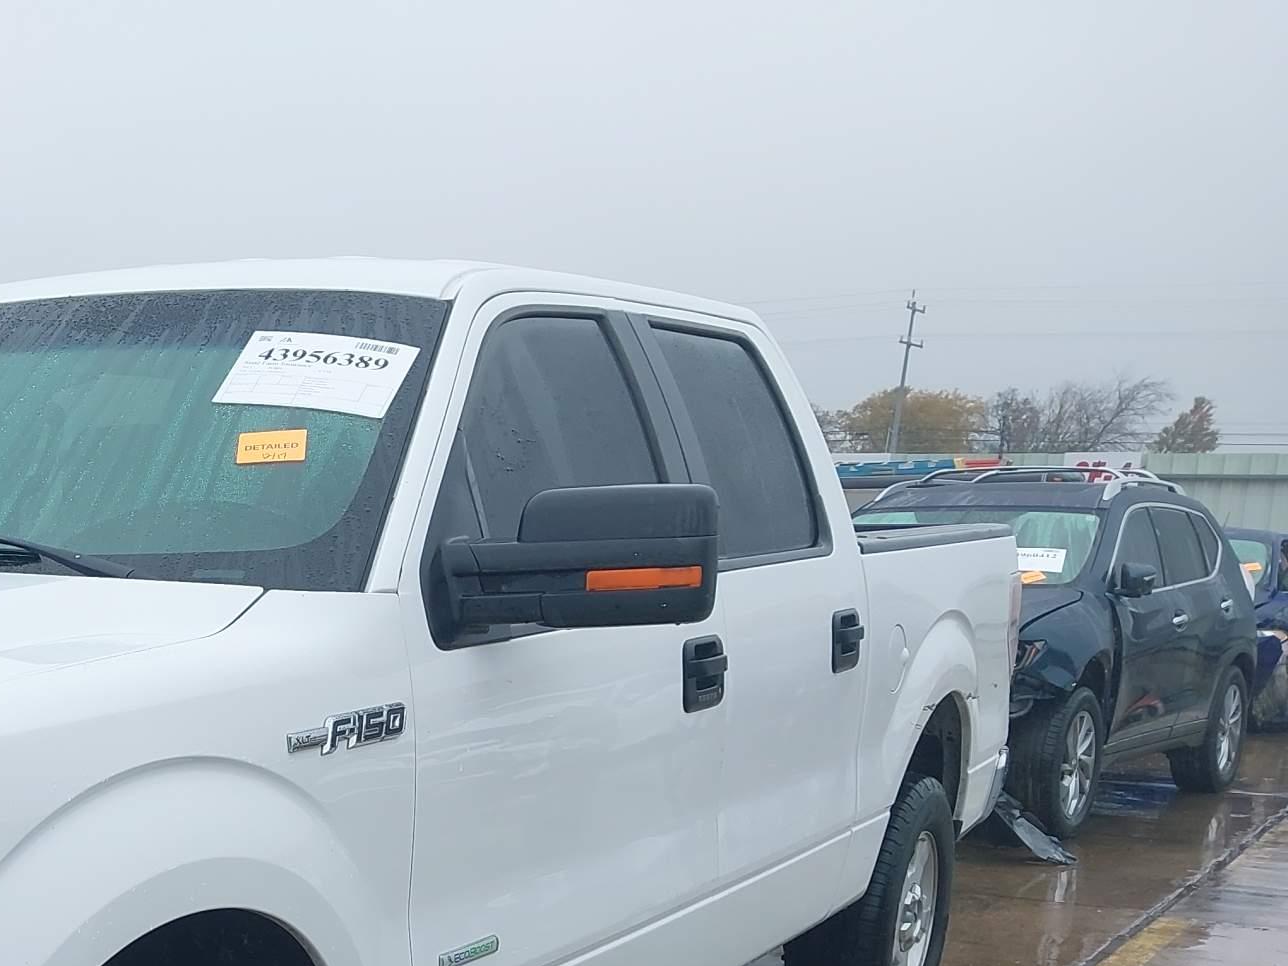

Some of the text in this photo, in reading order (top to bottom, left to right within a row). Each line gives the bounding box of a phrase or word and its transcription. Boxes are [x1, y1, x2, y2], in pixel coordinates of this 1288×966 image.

[258, 346, 390, 370] 43956389
[244, 442, 300, 452] DETAILED
[295, 734, 311, 746] XLT
